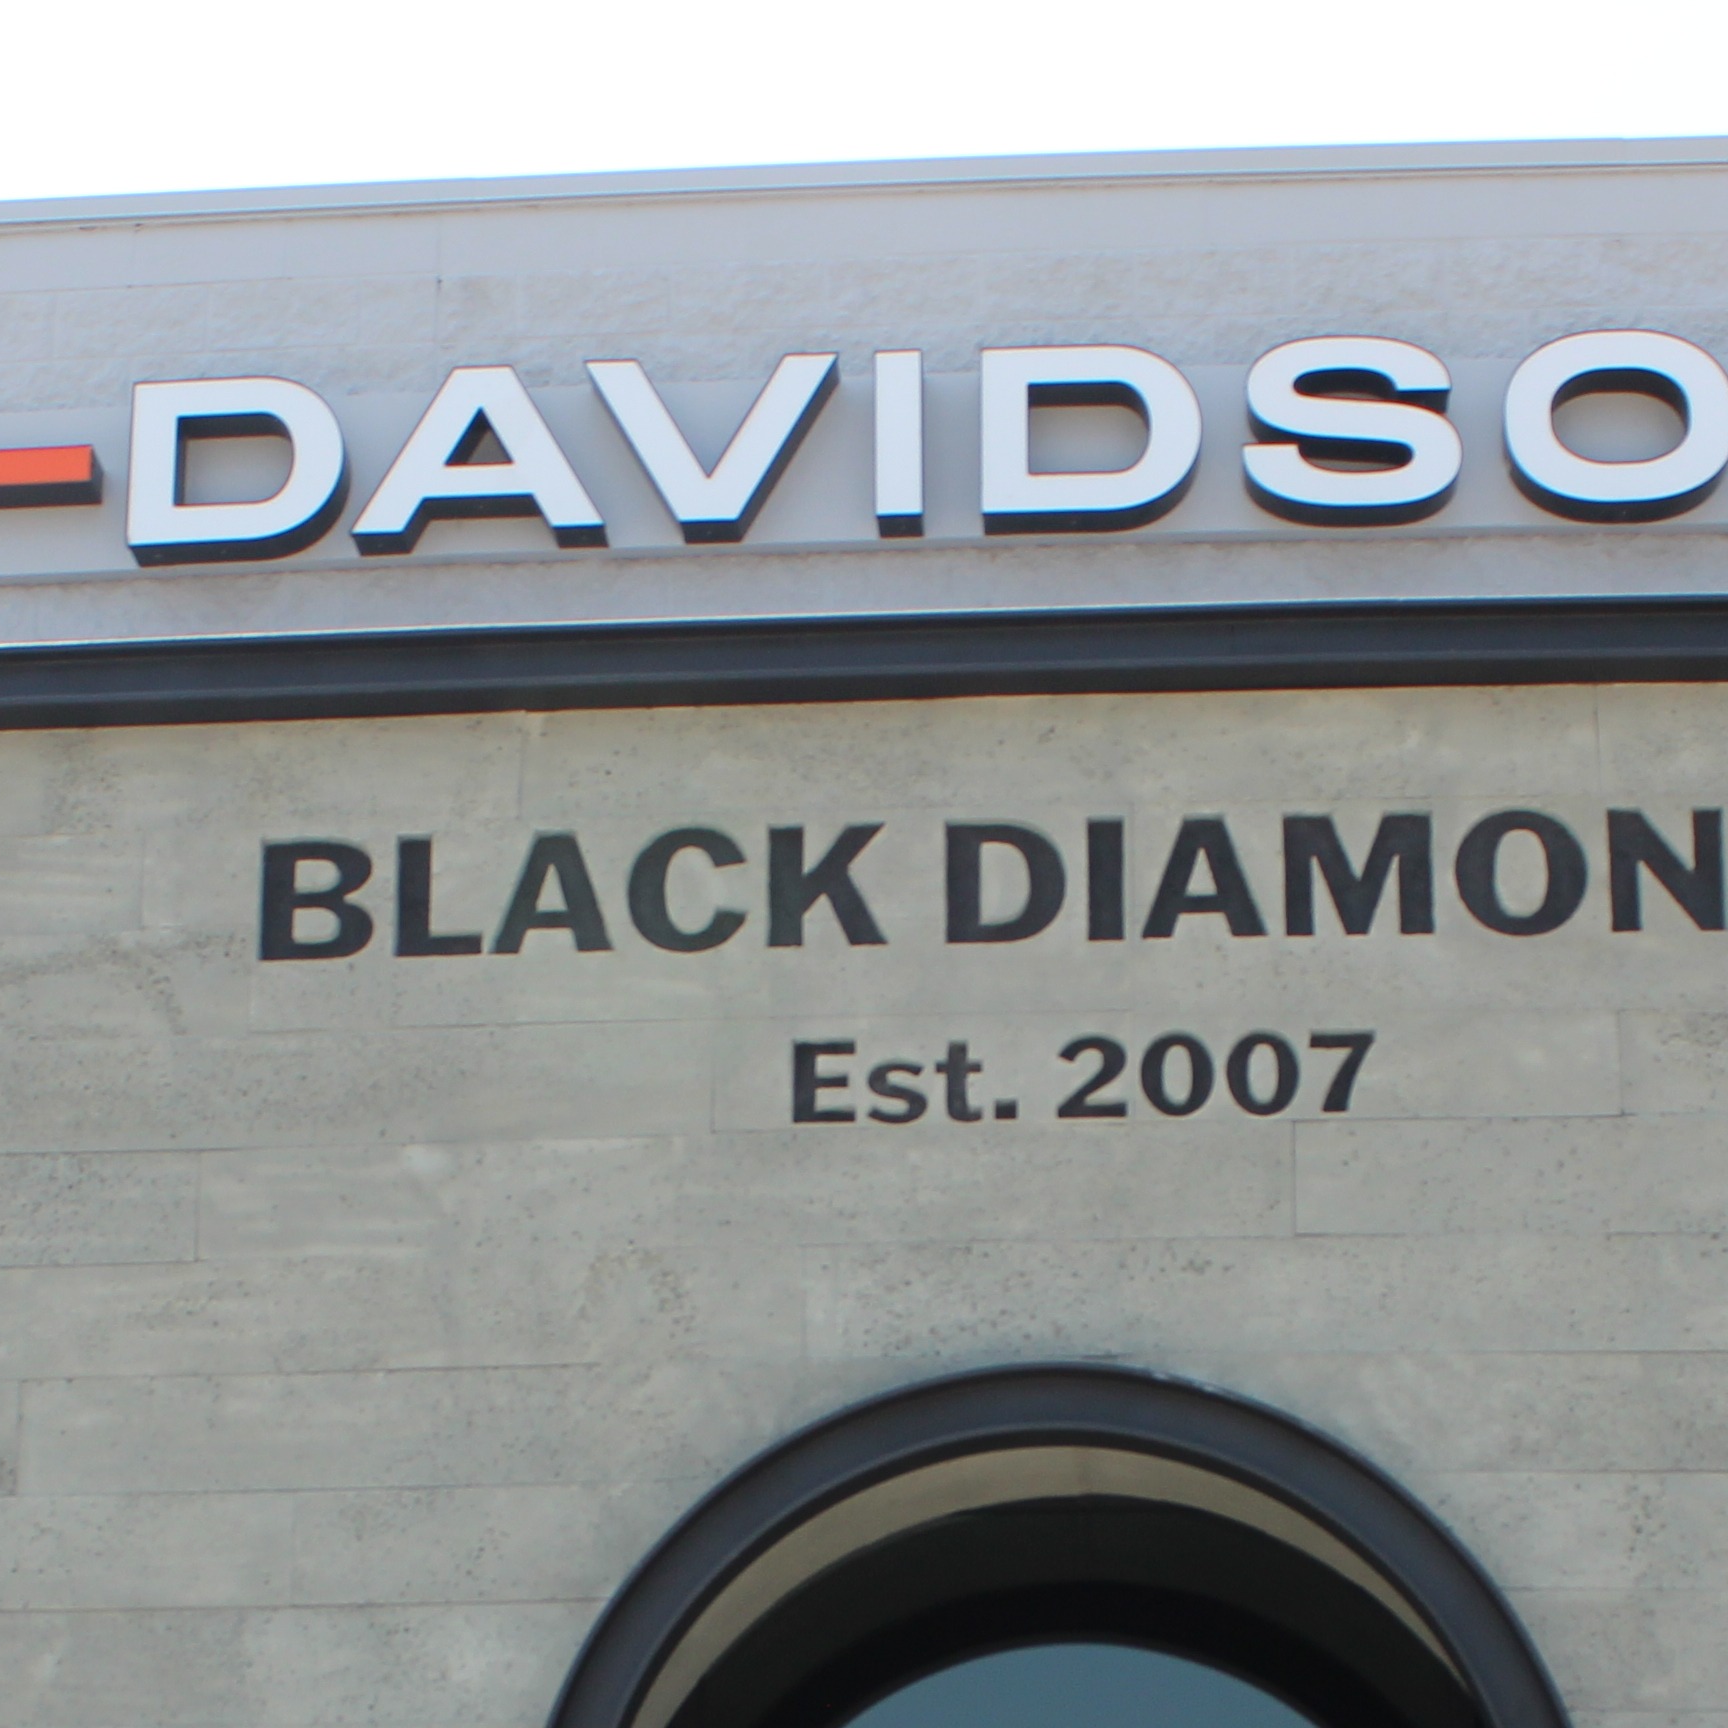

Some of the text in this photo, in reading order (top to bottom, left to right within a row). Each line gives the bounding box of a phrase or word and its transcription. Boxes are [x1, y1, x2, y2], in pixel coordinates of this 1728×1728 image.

[258, 822, 889, 961] BLACK
[791, 1030, 1376, 1124] Est. 2007
